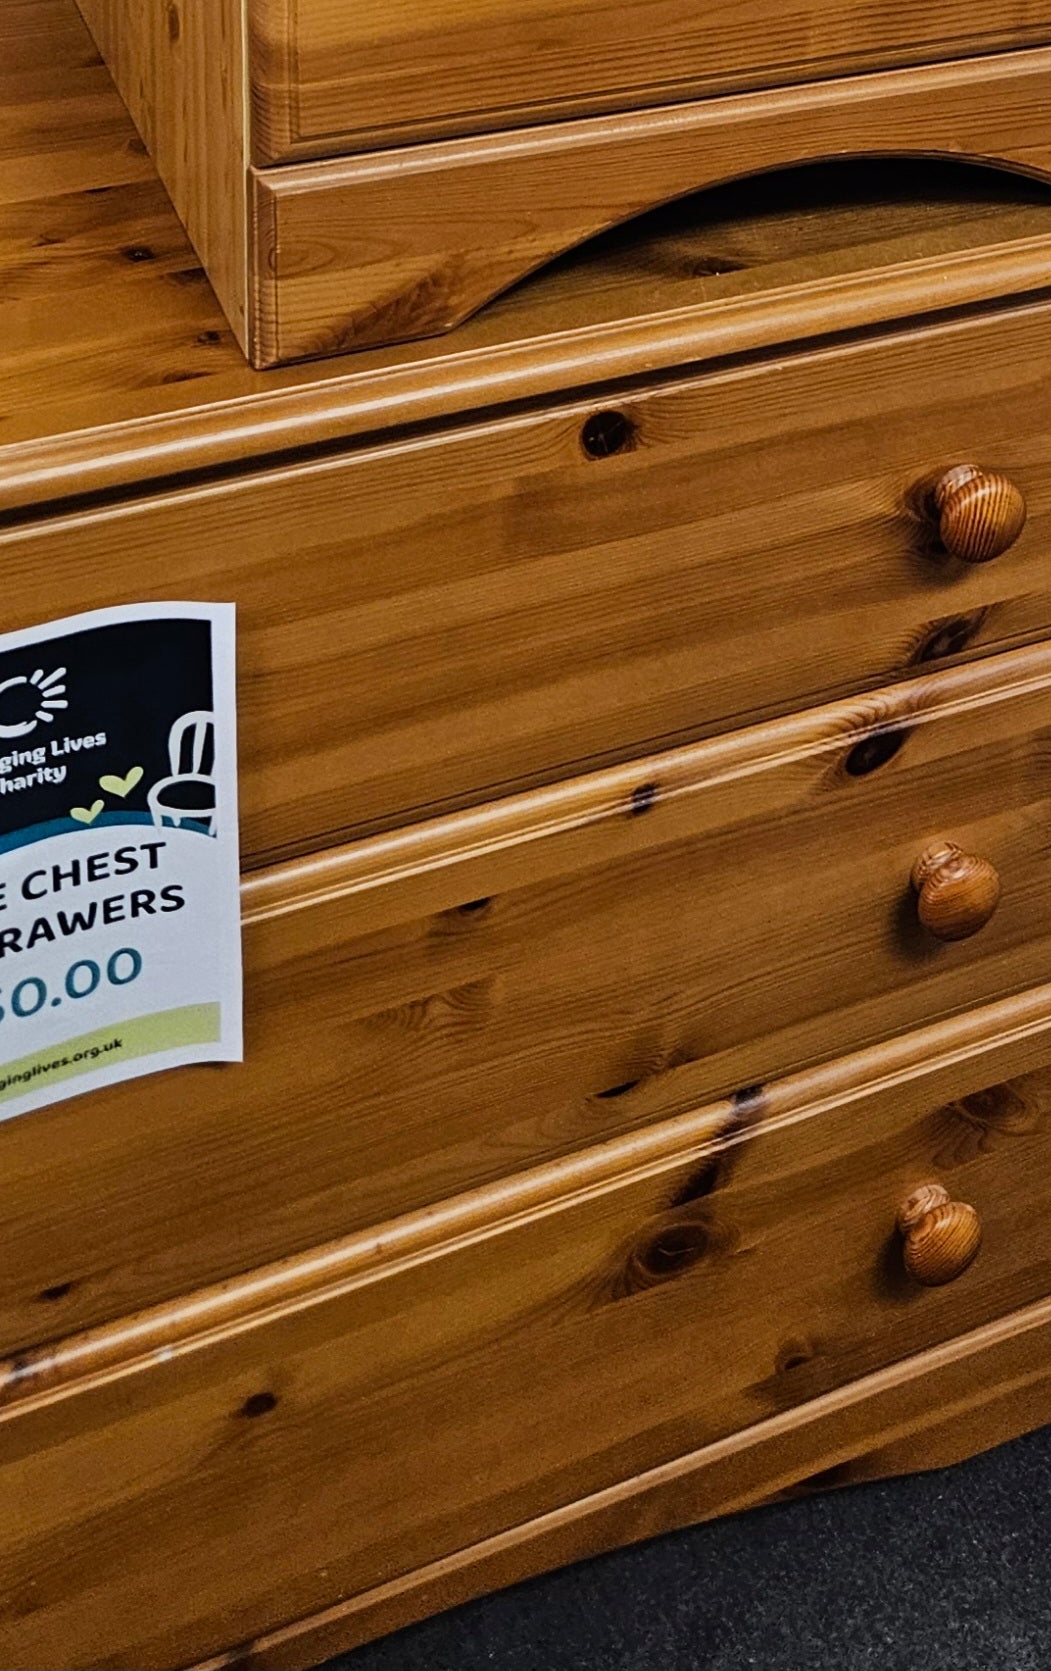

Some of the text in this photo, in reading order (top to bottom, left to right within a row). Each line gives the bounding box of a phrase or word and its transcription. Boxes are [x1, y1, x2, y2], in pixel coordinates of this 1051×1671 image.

[50, 732, 107, 757] Lives
[21, 841, 167, 901] CHEST
[0, 884, 186, 959] RAWERS
[0, 947, 143, 1023] 0.00
